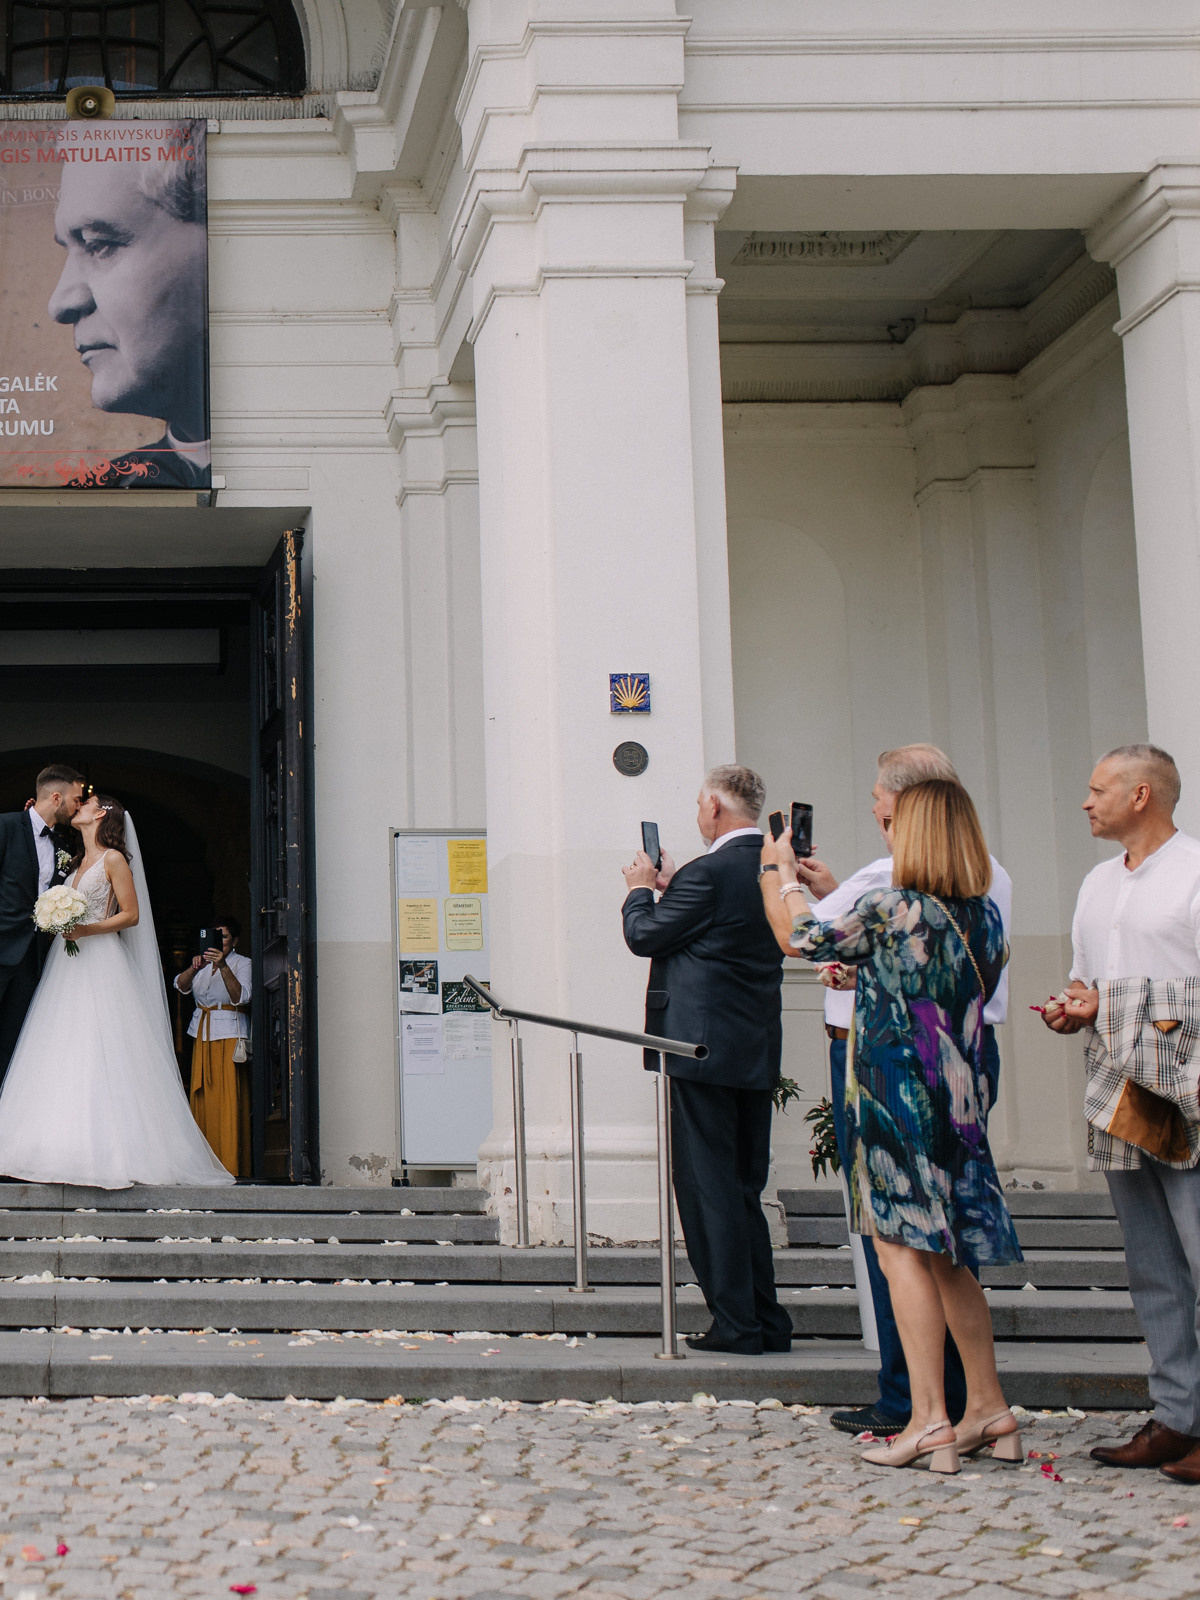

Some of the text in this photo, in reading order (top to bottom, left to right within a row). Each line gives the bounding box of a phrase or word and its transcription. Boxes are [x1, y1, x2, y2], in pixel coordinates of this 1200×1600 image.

[83, 128, 191, 141] ARKIVYSKUPAS
[36, 147, 152, 163] MATULAITIS
[157, 146, 196, 161] MIC
[2, 191, 17, 202] IN
